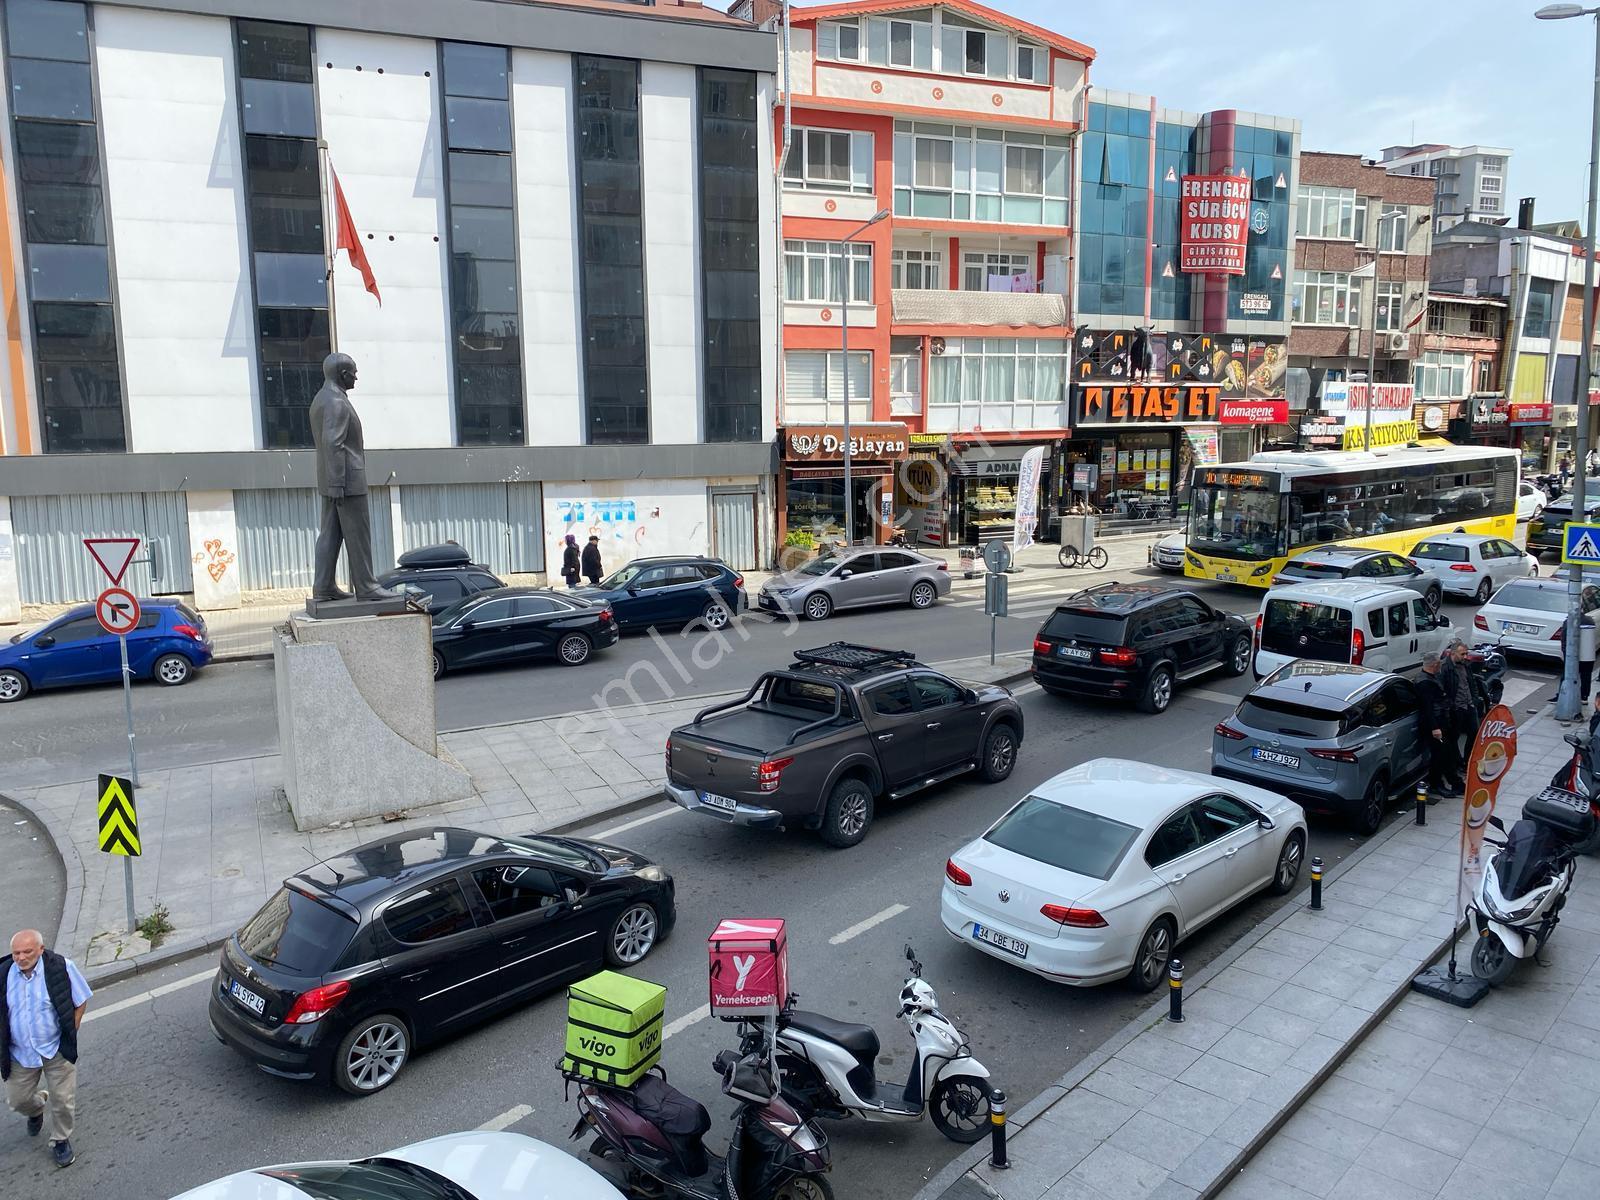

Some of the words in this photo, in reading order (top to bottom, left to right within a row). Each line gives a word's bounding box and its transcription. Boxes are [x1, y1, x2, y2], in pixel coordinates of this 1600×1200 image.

[1188, 200, 1247, 219] SÜRÜCÜ
[1188, 387, 1220, 416] ET
[1223, 403, 1274, 420] komagene
[823, 434, 905, 455] Dağlayan
[1346, 422, 1417, 448] KAATIYORUZ
[979, 927, 989, 939] 34
[993, 933, 1007, 946] CBE
[1011, 940, 1025, 953] 139
[242, 989, 255, 1004] SYP
[715, 994, 778, 1005] Yemeksepeti
[580, 1036, 616, 1057] vigo
[639, 1029, 658, 1052] vigo
